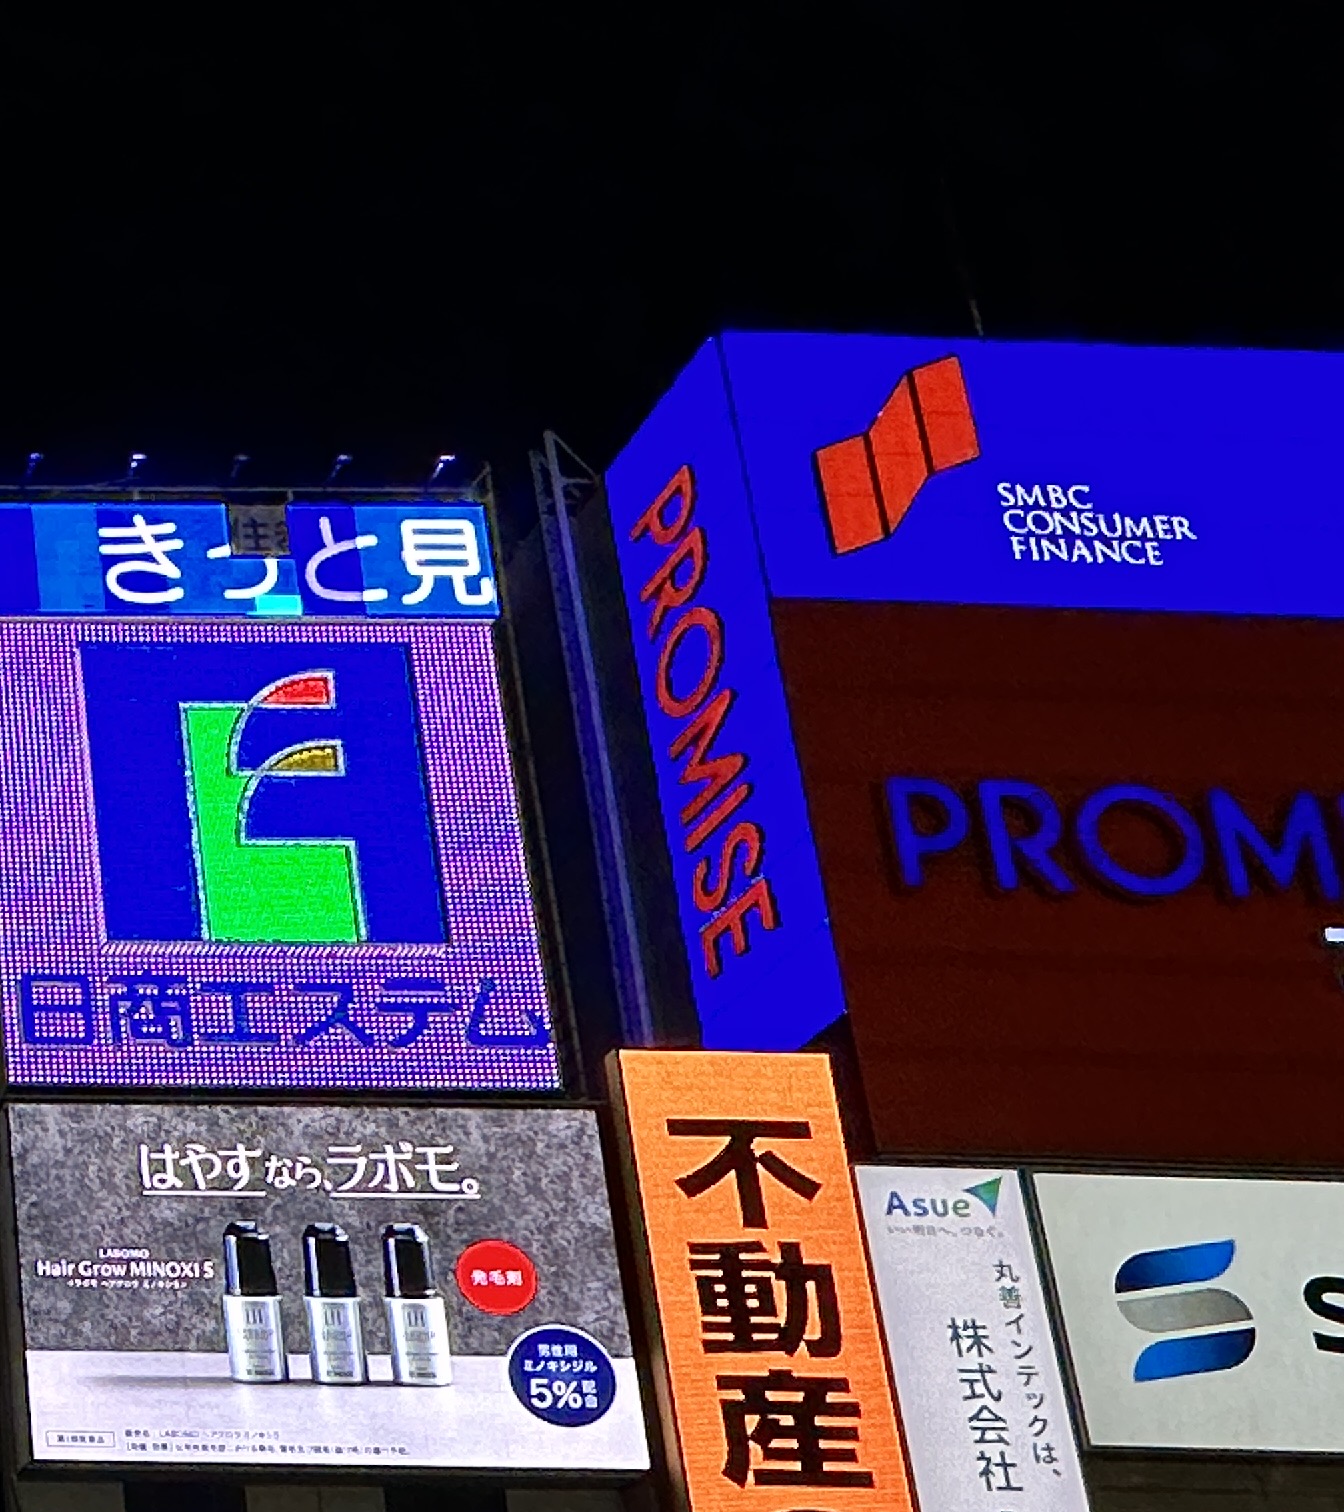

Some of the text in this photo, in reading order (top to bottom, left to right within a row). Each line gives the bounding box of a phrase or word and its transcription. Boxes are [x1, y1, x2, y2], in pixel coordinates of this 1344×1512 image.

[997, 481, 1094, 510] SMBC
[1001, 509, 1198, 541] CONSUMER
[1009, 537, 1165, 567] FINANCE
[628, 464, 779, 979] PROMISE
[882, 774, 1344, 902] PROM
[17, 970, 554, 1051] 日商エステム
[138, 1142, 481, 1195] はやすなら、ラボモ。
[885, 1190, 972, 1219] Asue
[36, 1260, 75, 1278] Hair
[78, 1260, 128, 1278] Grow
[992, 1259, 1062, 1477] 丸善インテックは、
[529, 1378, 584, 1410] 5%
[947, 1316, 1024, 1492] 株式会社
